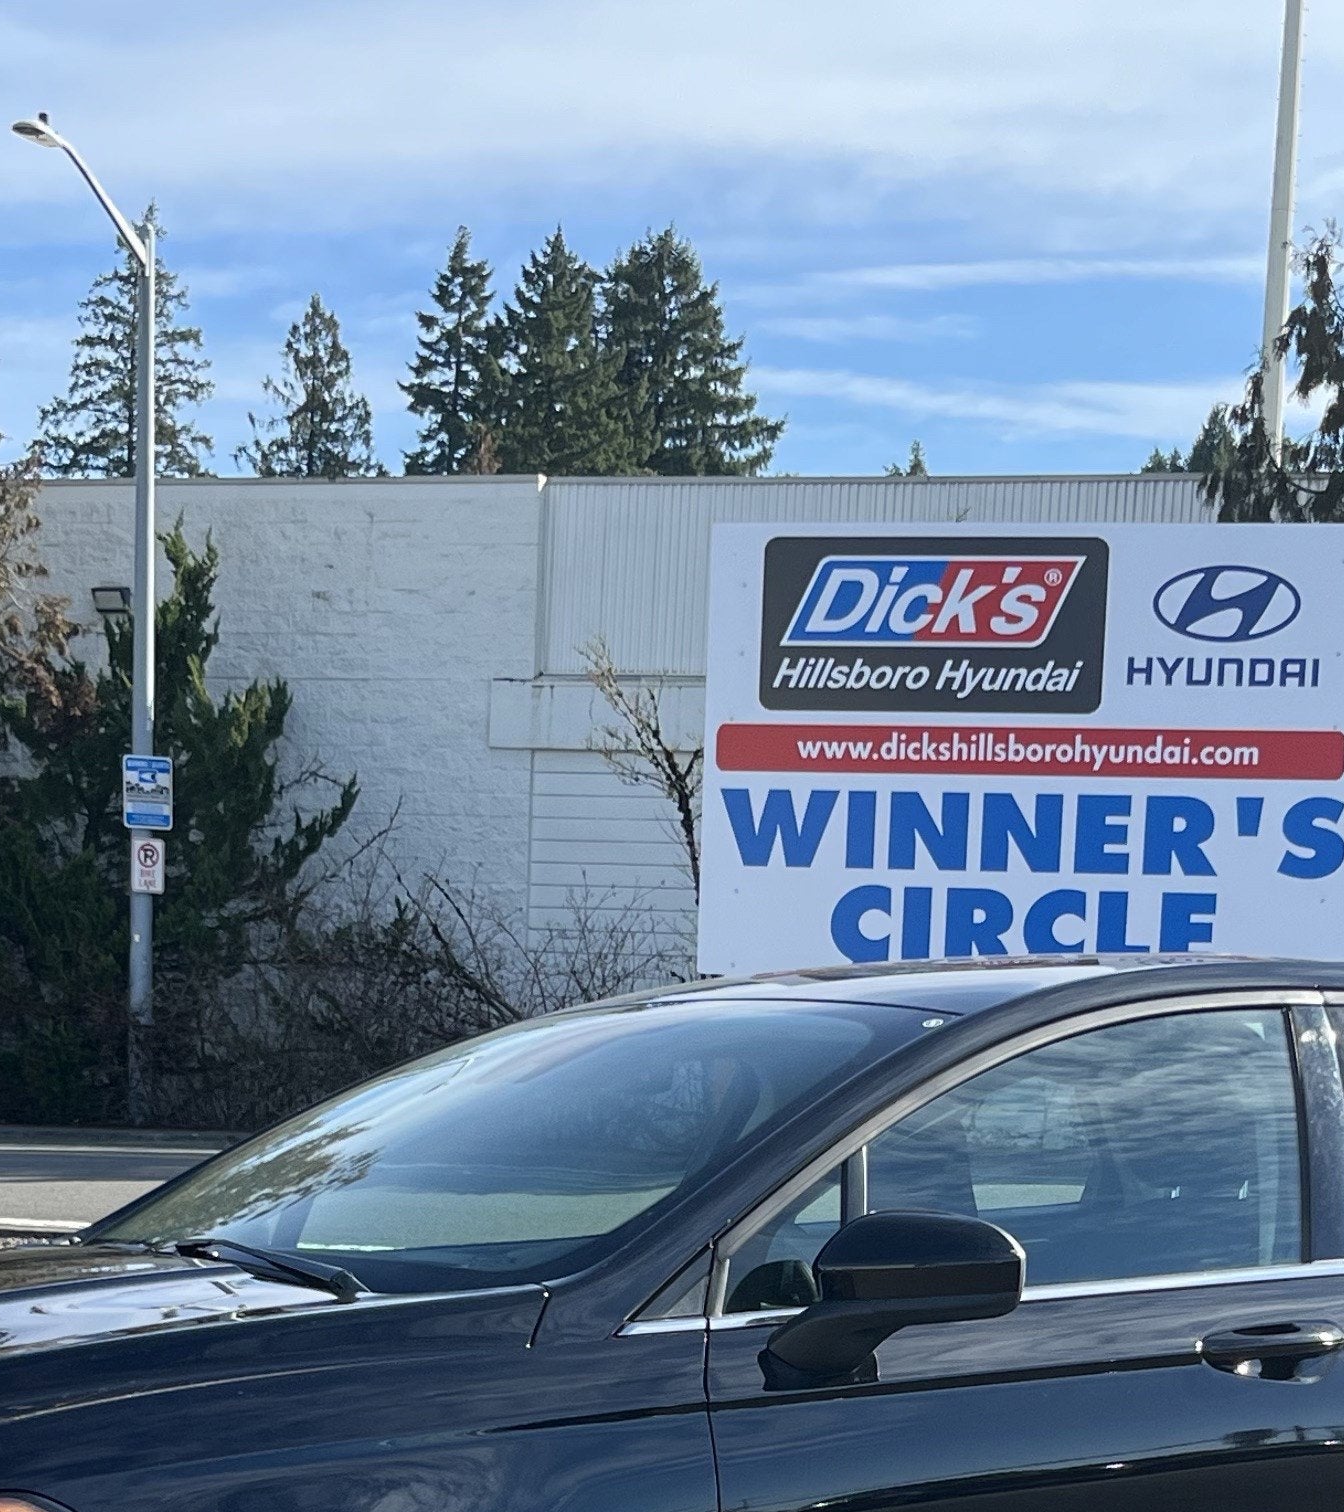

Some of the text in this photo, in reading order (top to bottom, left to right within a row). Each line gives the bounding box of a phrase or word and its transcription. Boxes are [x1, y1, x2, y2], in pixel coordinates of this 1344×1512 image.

[804, 566, 1047, 636] Dick's
[771, 656, 1085, 699] Hillsboro Hyundai
[1126, 656, 1320, 688] HYUNDAI
[796, 734, 1259, 772] www.dickshillsborohyundai.com
[830, 884, 1218, 964] CIRCLE
